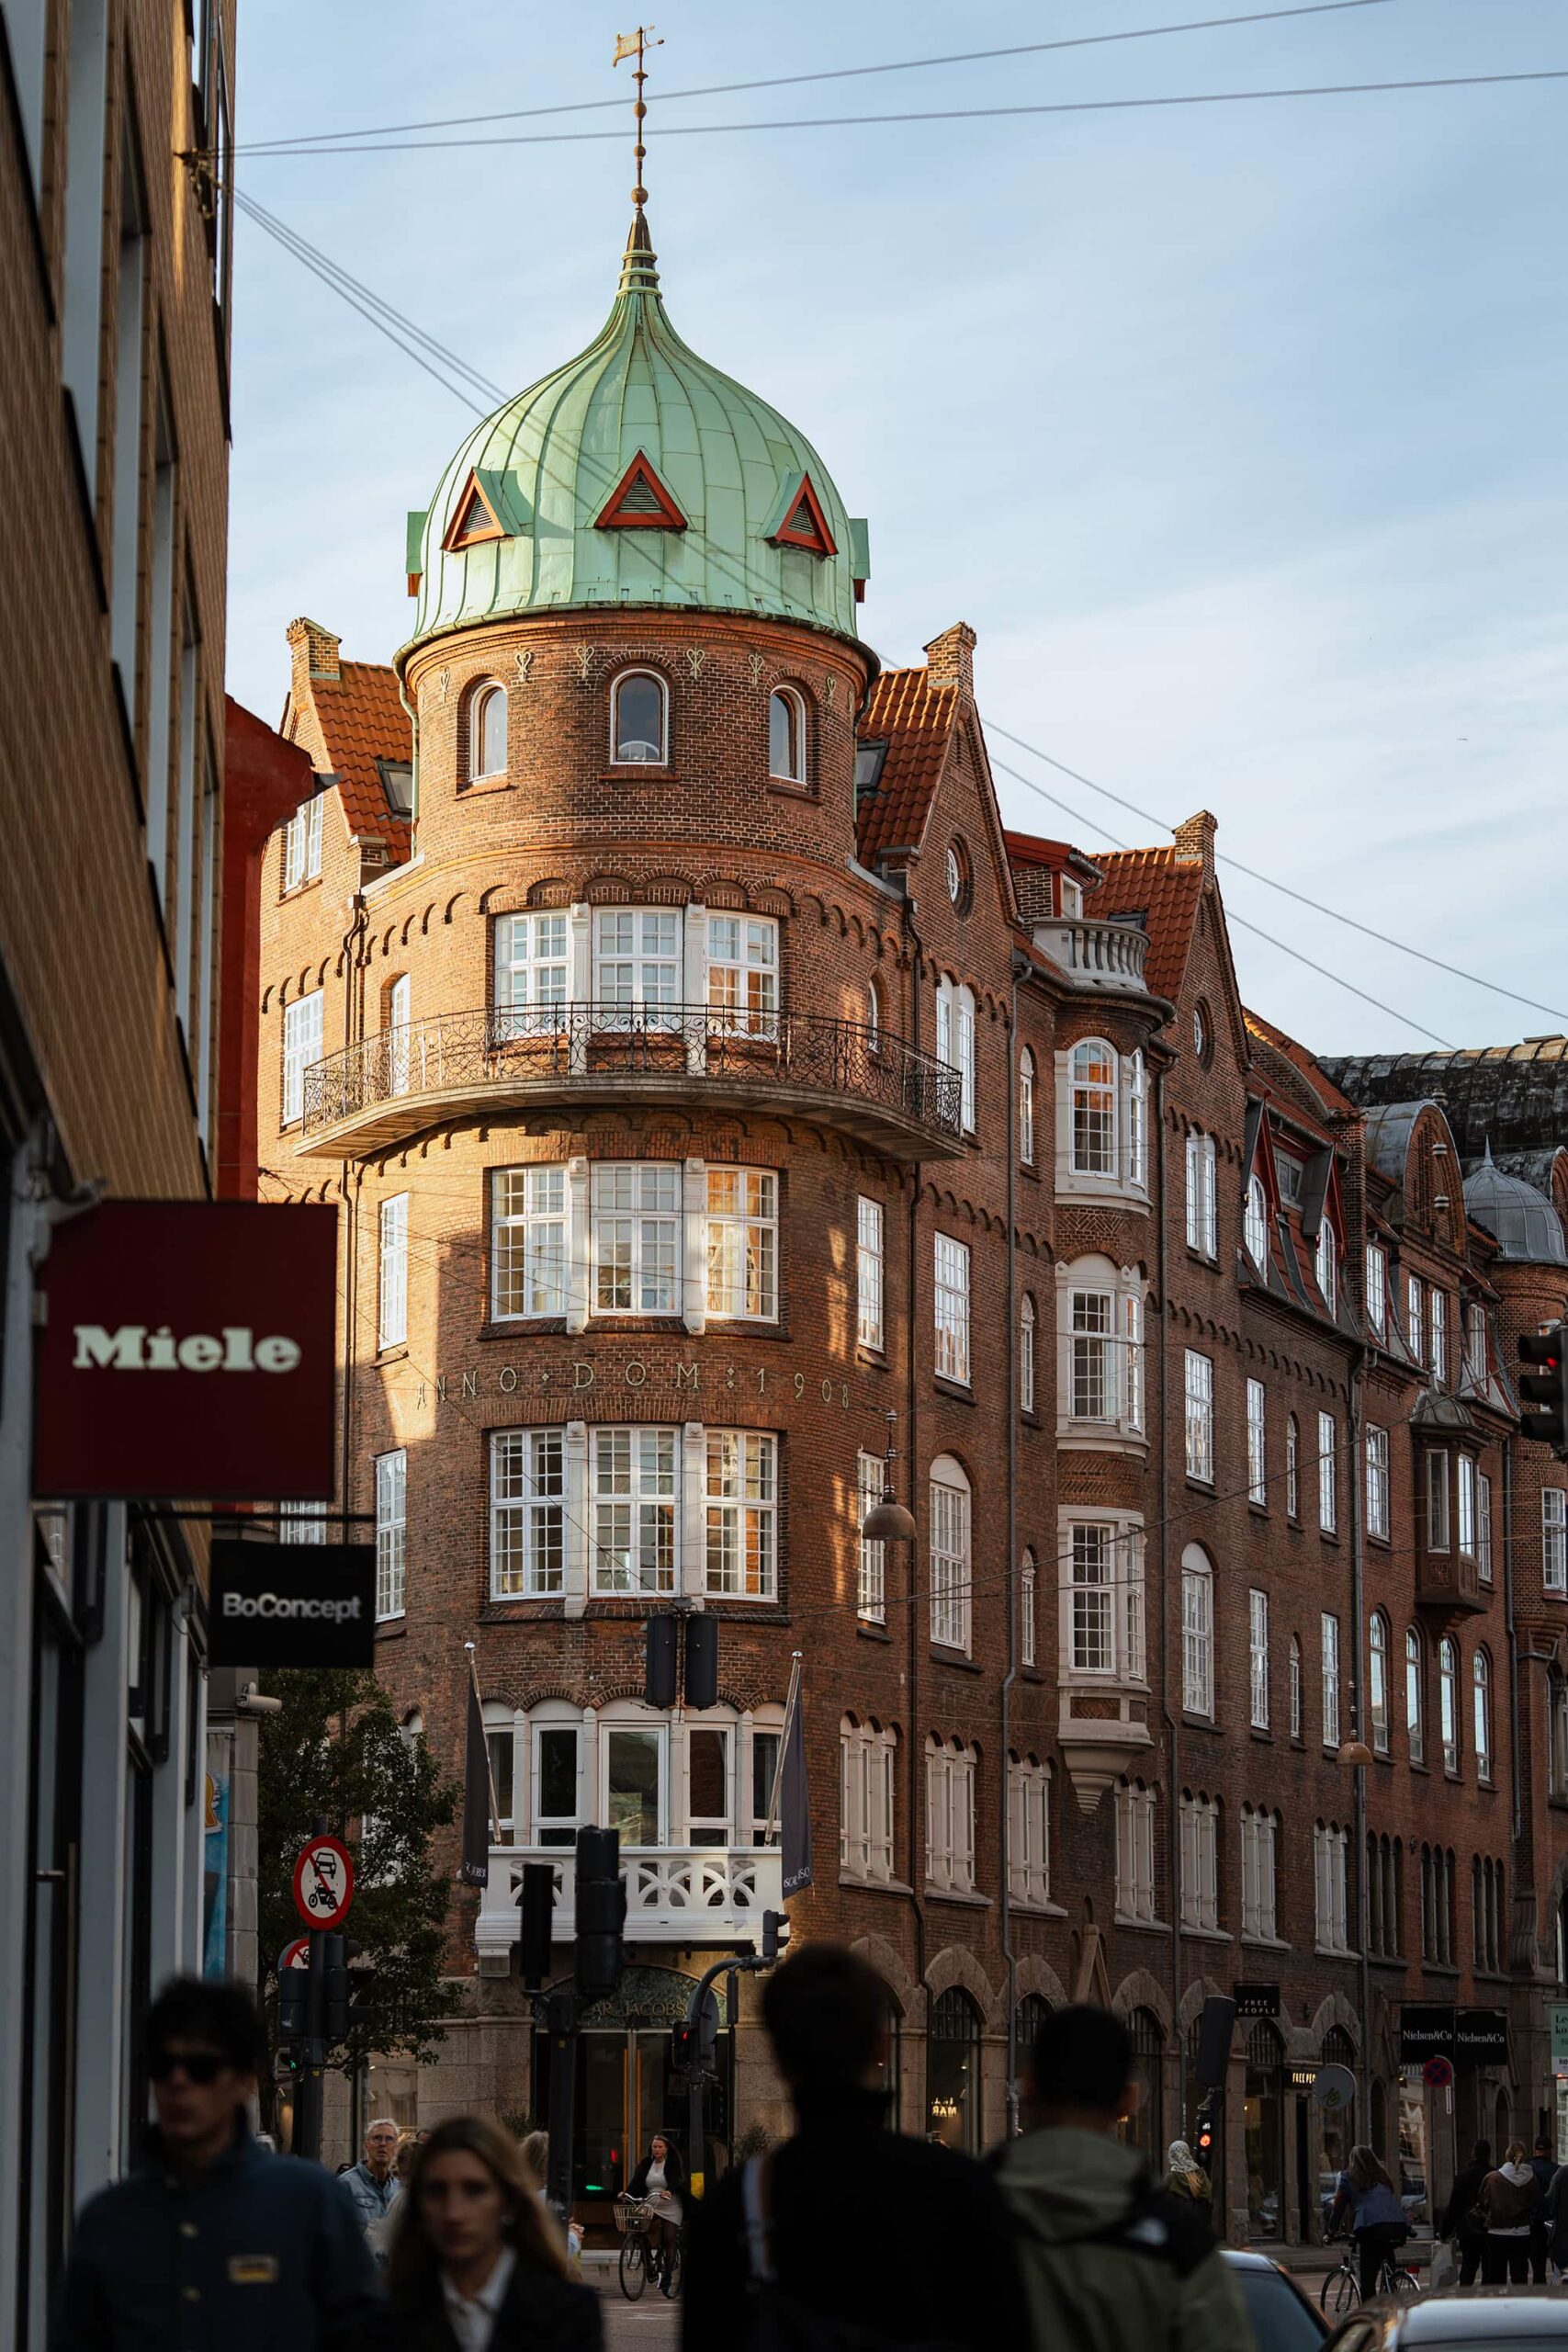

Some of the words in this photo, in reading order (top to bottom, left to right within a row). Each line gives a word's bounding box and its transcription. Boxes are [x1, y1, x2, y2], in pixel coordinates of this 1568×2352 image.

[73, 1325, 301, 1373] Miele
[416, 1366, 518, 1410] ANNO
[756, 1367, 850, 1409] 1908
[222, 1592, 362, 1624] BoConcept
[1245, 1998, 1269, 2007] FREE
[1237, 2007, 1277, 2015] PEOPLE
[1402, 2030, 1453, 2041] Nielsen&Co
[1456, 2032, 1506, 2043] Nielsen&Co
